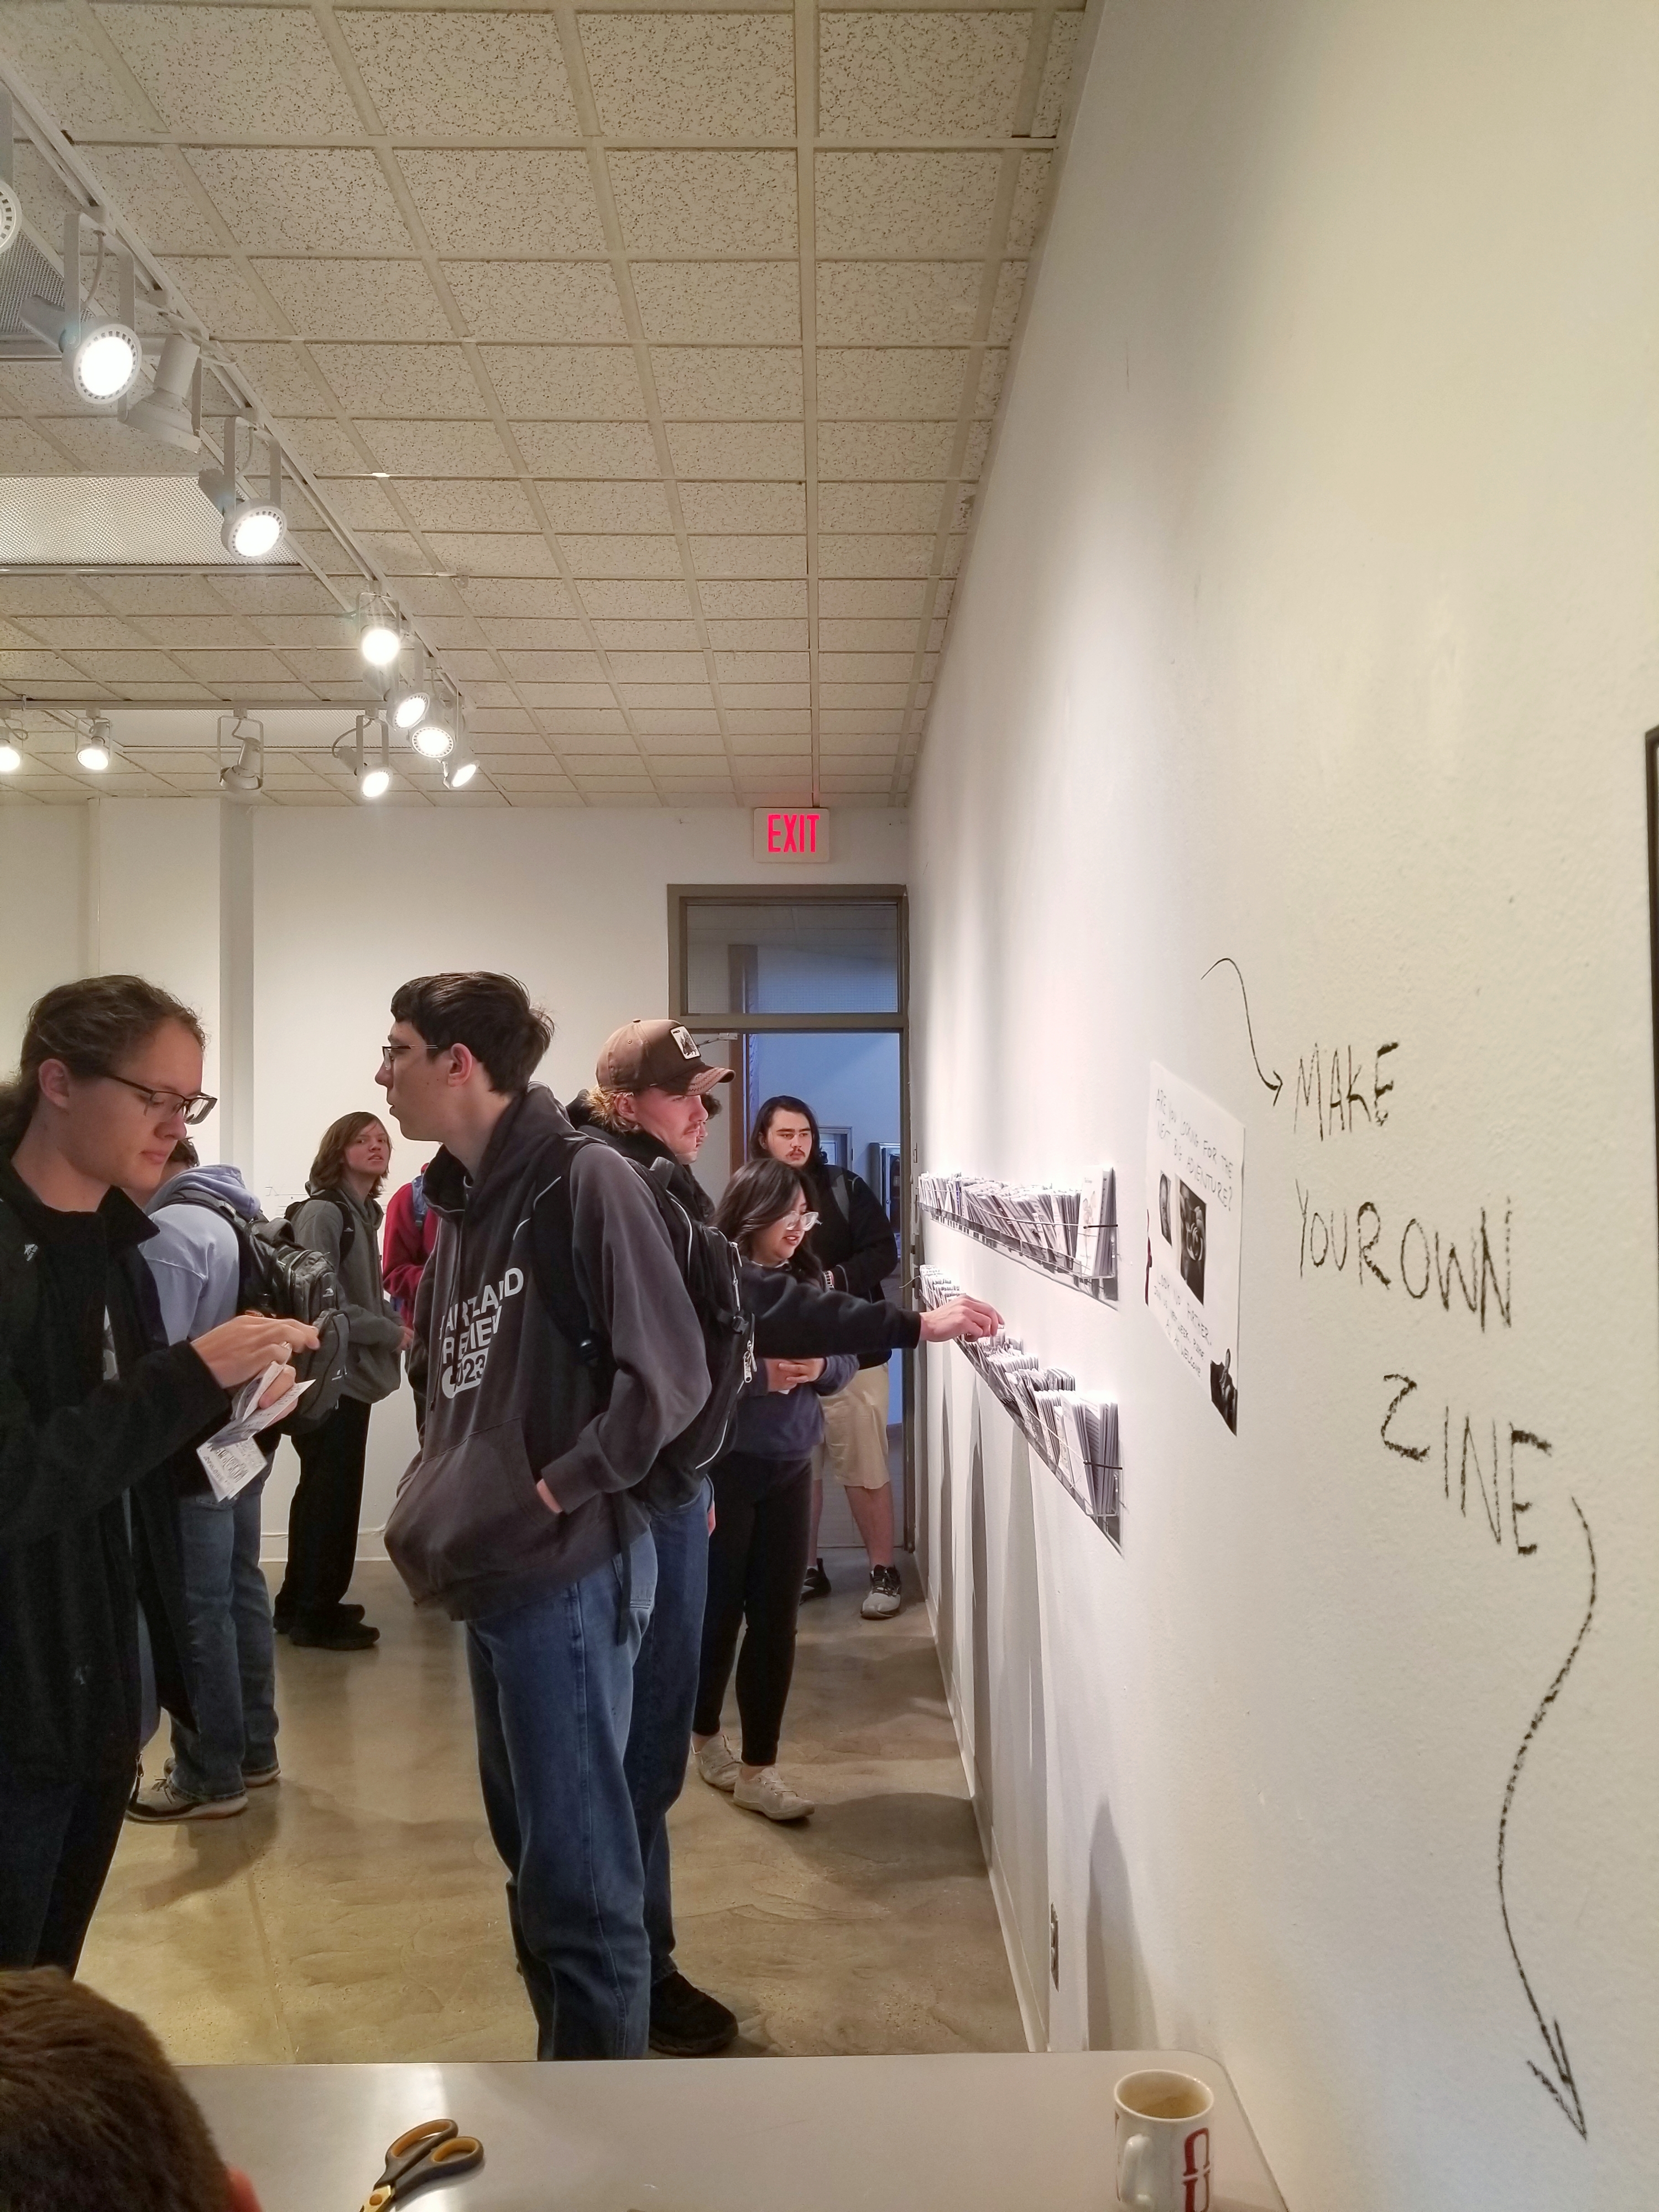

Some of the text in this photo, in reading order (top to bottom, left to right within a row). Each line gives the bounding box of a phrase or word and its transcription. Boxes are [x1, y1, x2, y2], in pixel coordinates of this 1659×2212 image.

[768, 813, 820, 853] EXIT
[1155, 1088, 1166, 1115] ARE
[1203, 1140, 1217, 1165] FOR
[1221, 1155, 1233, 1179] THE
[1293, 1041, 1399, 1141] MAKE
[1186, 1156, 1233, 1212] ADVENTURE?
[1294, 1177, 1512, 1333] YOUR OWN
[1381, 1373, 1553, 1556] ZINE
